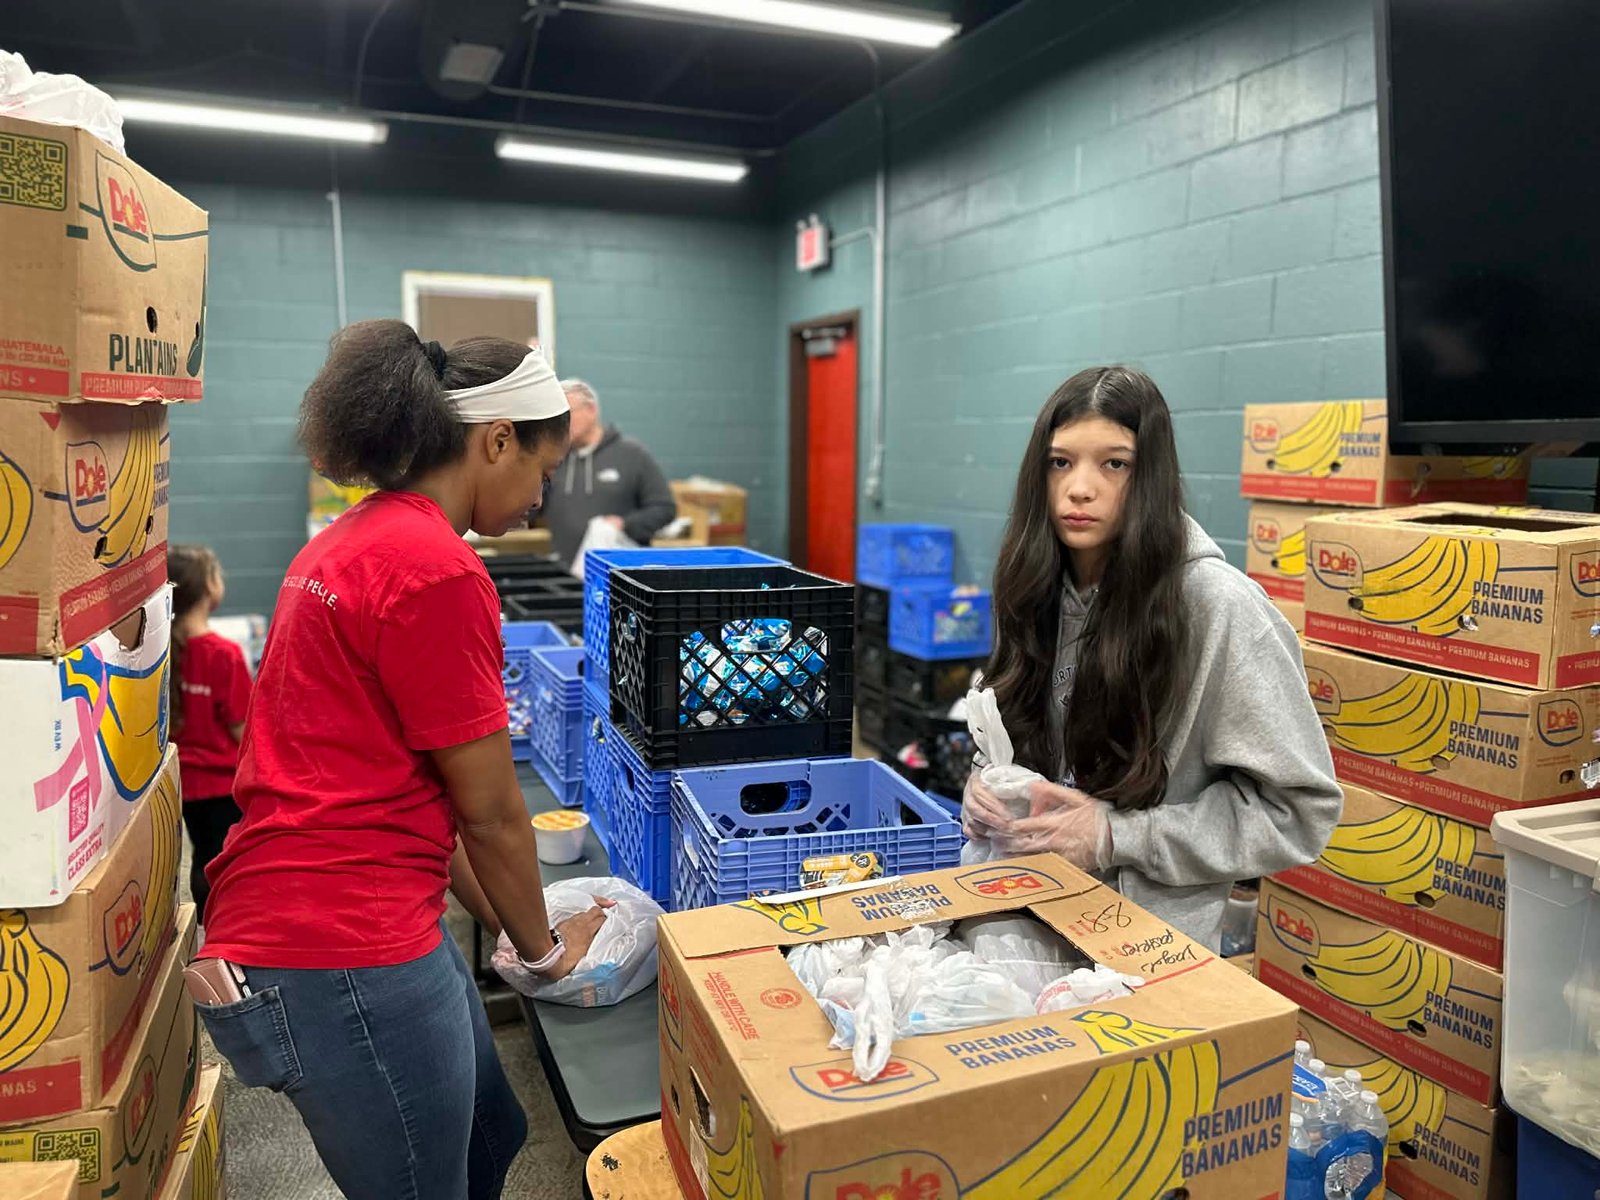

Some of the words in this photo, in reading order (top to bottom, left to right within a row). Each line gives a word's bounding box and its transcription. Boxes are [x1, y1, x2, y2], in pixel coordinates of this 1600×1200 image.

[108, 177, 147, 233] Dole
[75, 456, 107, 497] Dole
[1319, 549, 1356, 571] Dole
[1578, 559, 1600, 579] Do
[1473, 581, 1543, 605] PREMIUM
[1472, 600, 1543, 624] BANANAS
[1372, 630, 1405, 644] PREMIUM
[1406, 637, 1441, 651] BANANAS
[1448, 645, 1486, 660] PREMIUM
[1488, 652, 1530, 668] BANANAS
[1308, 679, 1334, 698] ole
[1547, 708, 1578, 728] Dole
[1449, 721, 1519, 750] PREMIUM
[1447, 737, 1518, 769] BANANAS
[1418, 779, 1461, 801] PREMIUM
[1435, 857, 1505, 893] PREMIUM
[1433, 874, 1505, 912] BANANAS
[1277, 908, 1315, 939] Dole
[1426, 990, 1493, 1031] PREMIUM
[739, 1017, 760, 1039] CARE
[944, 1026, 1059, 1056] PREMIUM
[1424, 1007, 1493, 1049] BANANAS
[960, 1037, 1076, 1069] BANANAS
[1183, 1092, 1283, 1147] PREMIUM
[1181, 1123, 1282, 1178] BANANAS
[1412, 1137, 1479, 1186] BANANAS
[1414, 1121, 1480, 1170] PREMIUM
